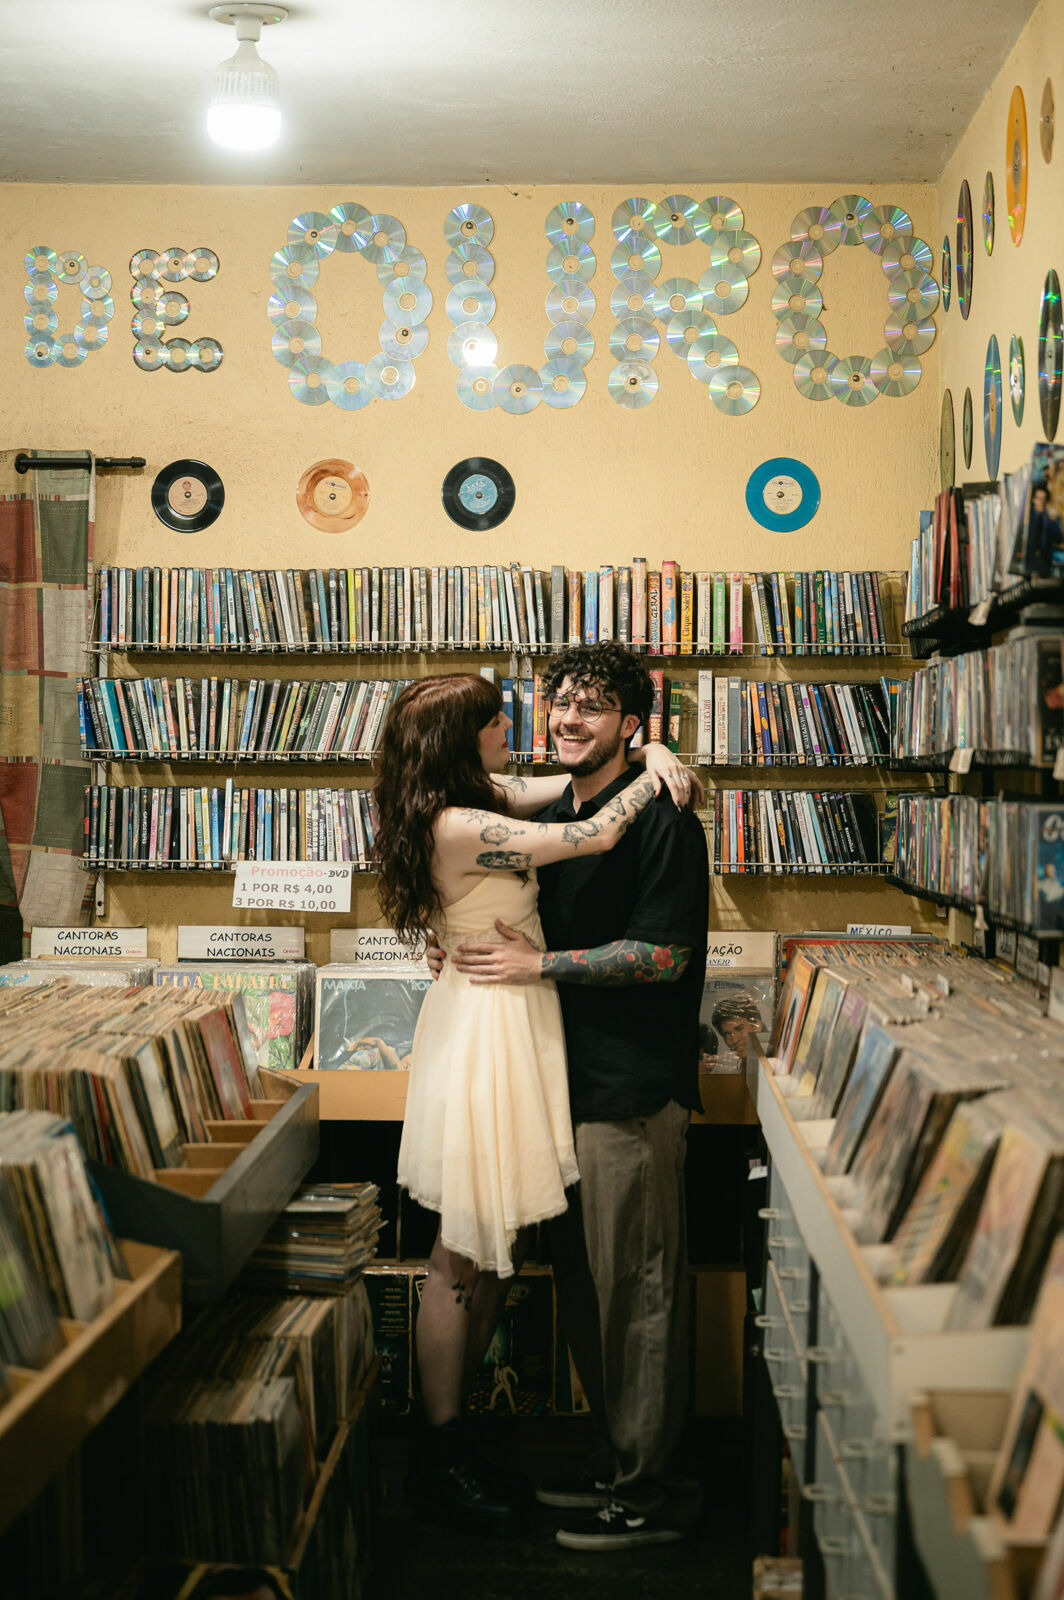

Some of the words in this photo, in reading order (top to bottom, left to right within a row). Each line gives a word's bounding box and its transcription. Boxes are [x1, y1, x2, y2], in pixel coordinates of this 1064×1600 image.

[650, 590, 659, 618] GERAL
[682, 594, 692, 612] Soleil
[682, 616, 692, 637] Cirque
[650, 718, 661, 740] BRUCE
[251, 865, 323, 880] Promoção
[240, 882, 248, 892] 1
[252, 883, 279, 893] POR
[284, 884, 300, 894] R$
[304, 884, 333, 896] 4,00
[235, 897, 242, 906] 3
[248, 898, 274, 907] POR
[278, 899, 296, 910] R$
[300, 900, 336, 912] 10,00
[57, 931, 119, 940] CANTORAS
[209, 932, 272, 942] CANTORAS
[53, 946, 122, 956] NACIONAIS
[206, 948, 276, 957] NACIONAIS
[354, 952, 424, 961] NACIONAIS
